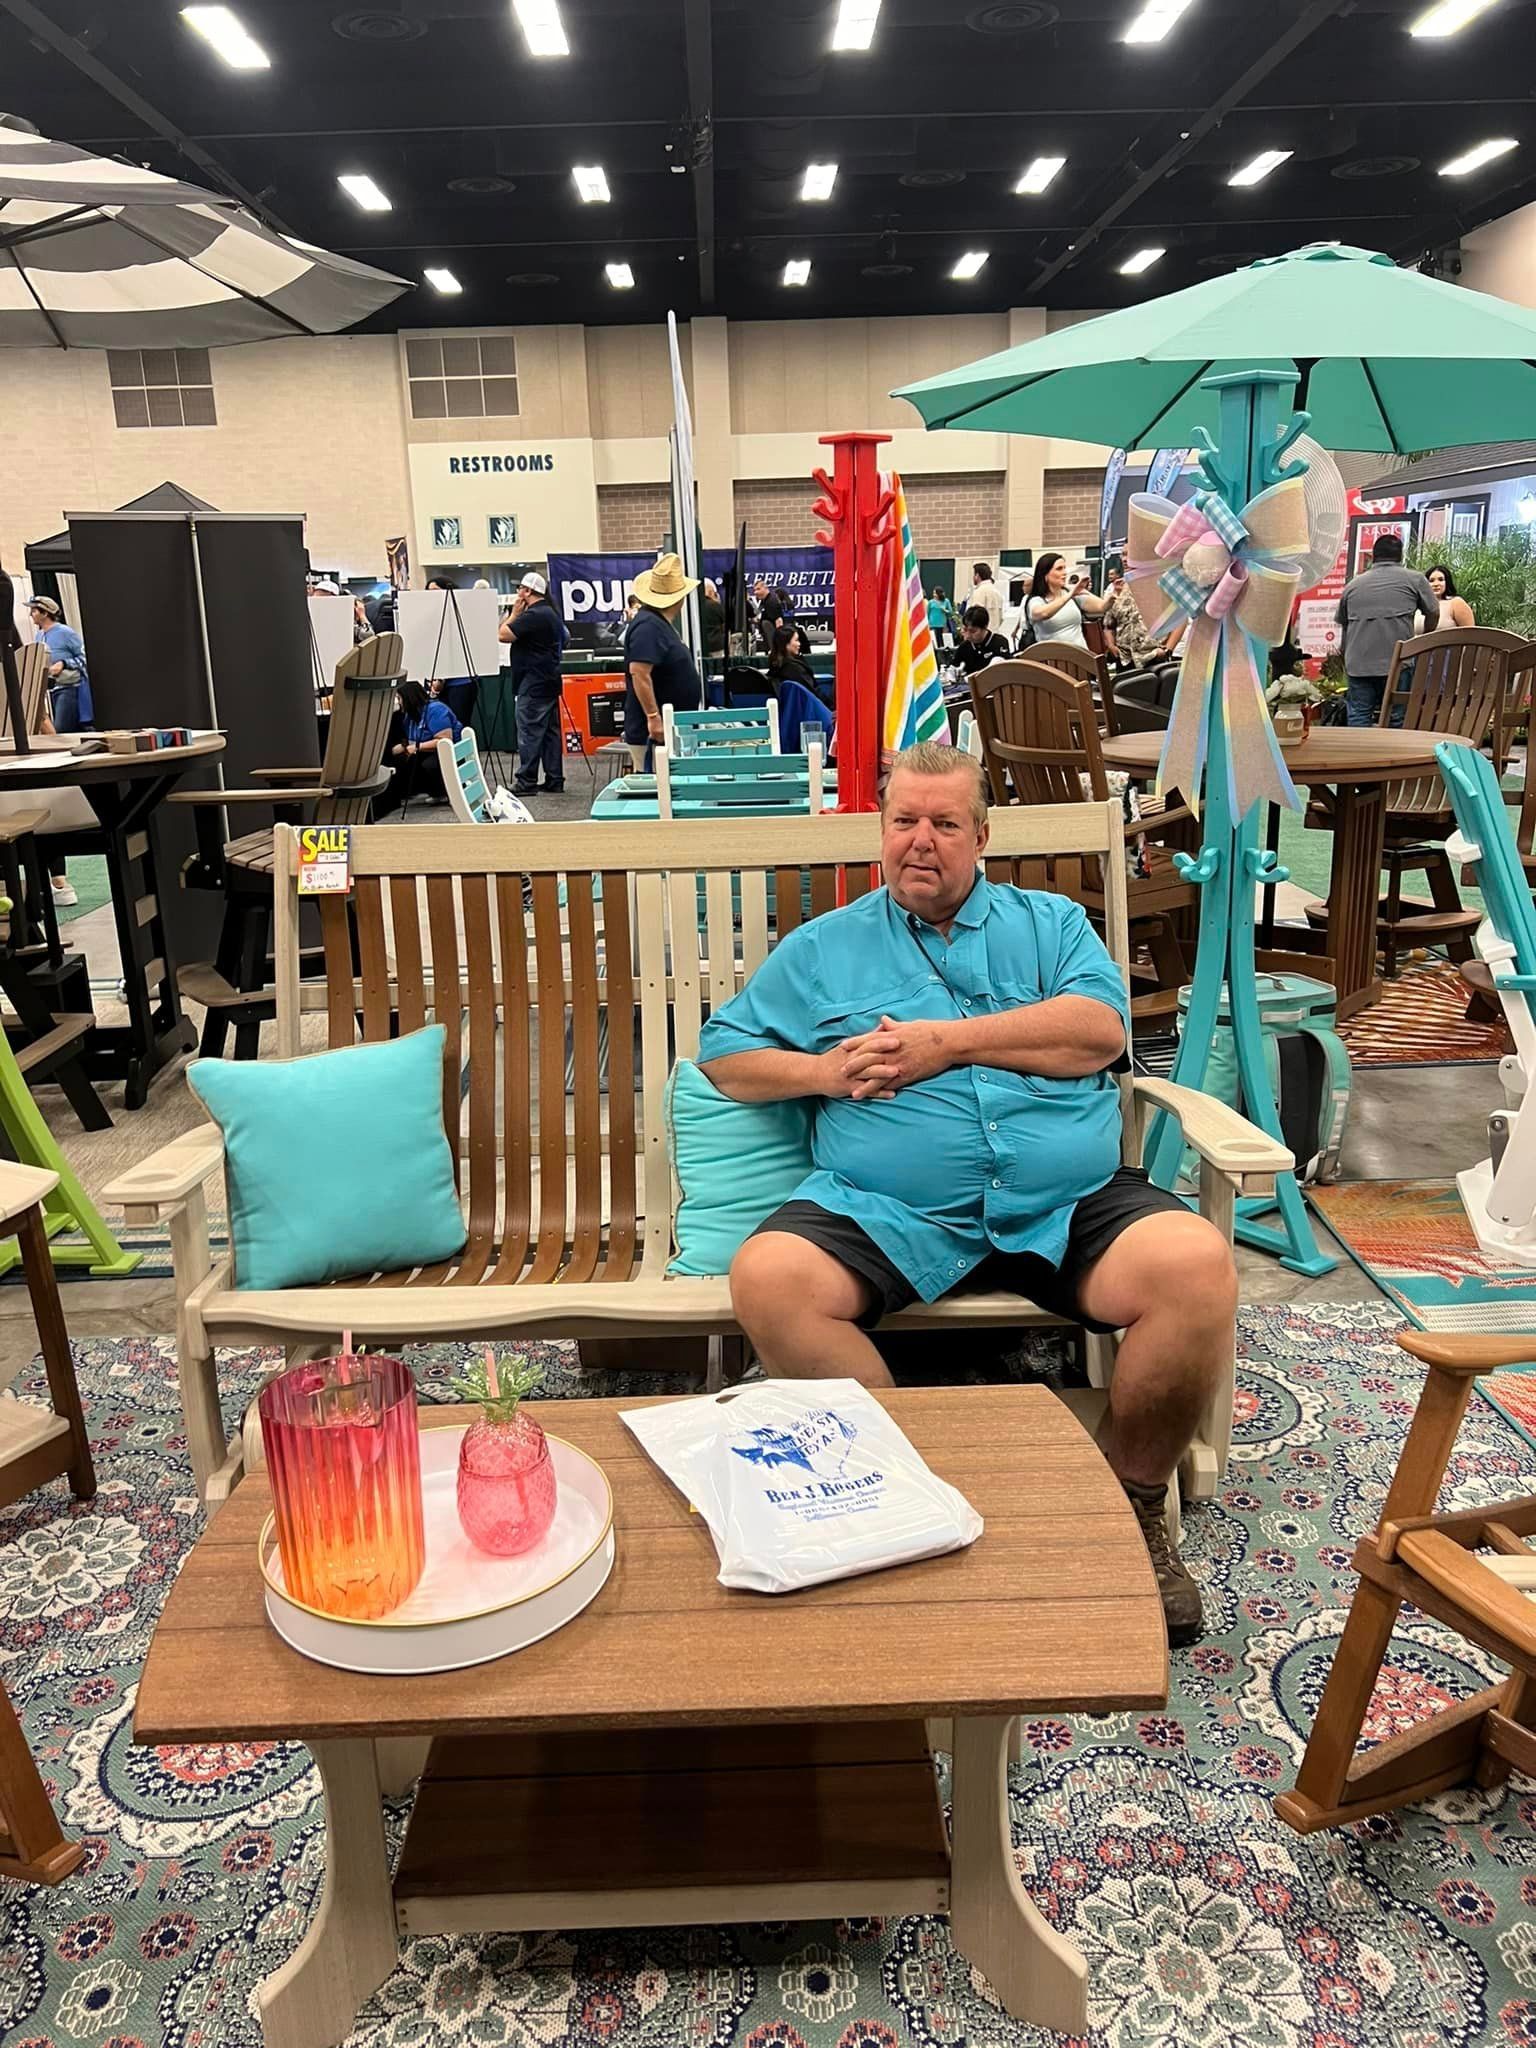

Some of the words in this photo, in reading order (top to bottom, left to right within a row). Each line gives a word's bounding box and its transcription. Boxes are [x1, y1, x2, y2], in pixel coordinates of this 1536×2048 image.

[449, 454, 553, 474] RESTROOMS
[744, 571, 784, 588] LEEP
[303, 829, 348, 862] SALE
[764, 1487, 801, 1504] BEN
[819, 1470, 884, 1497] ROGERS
